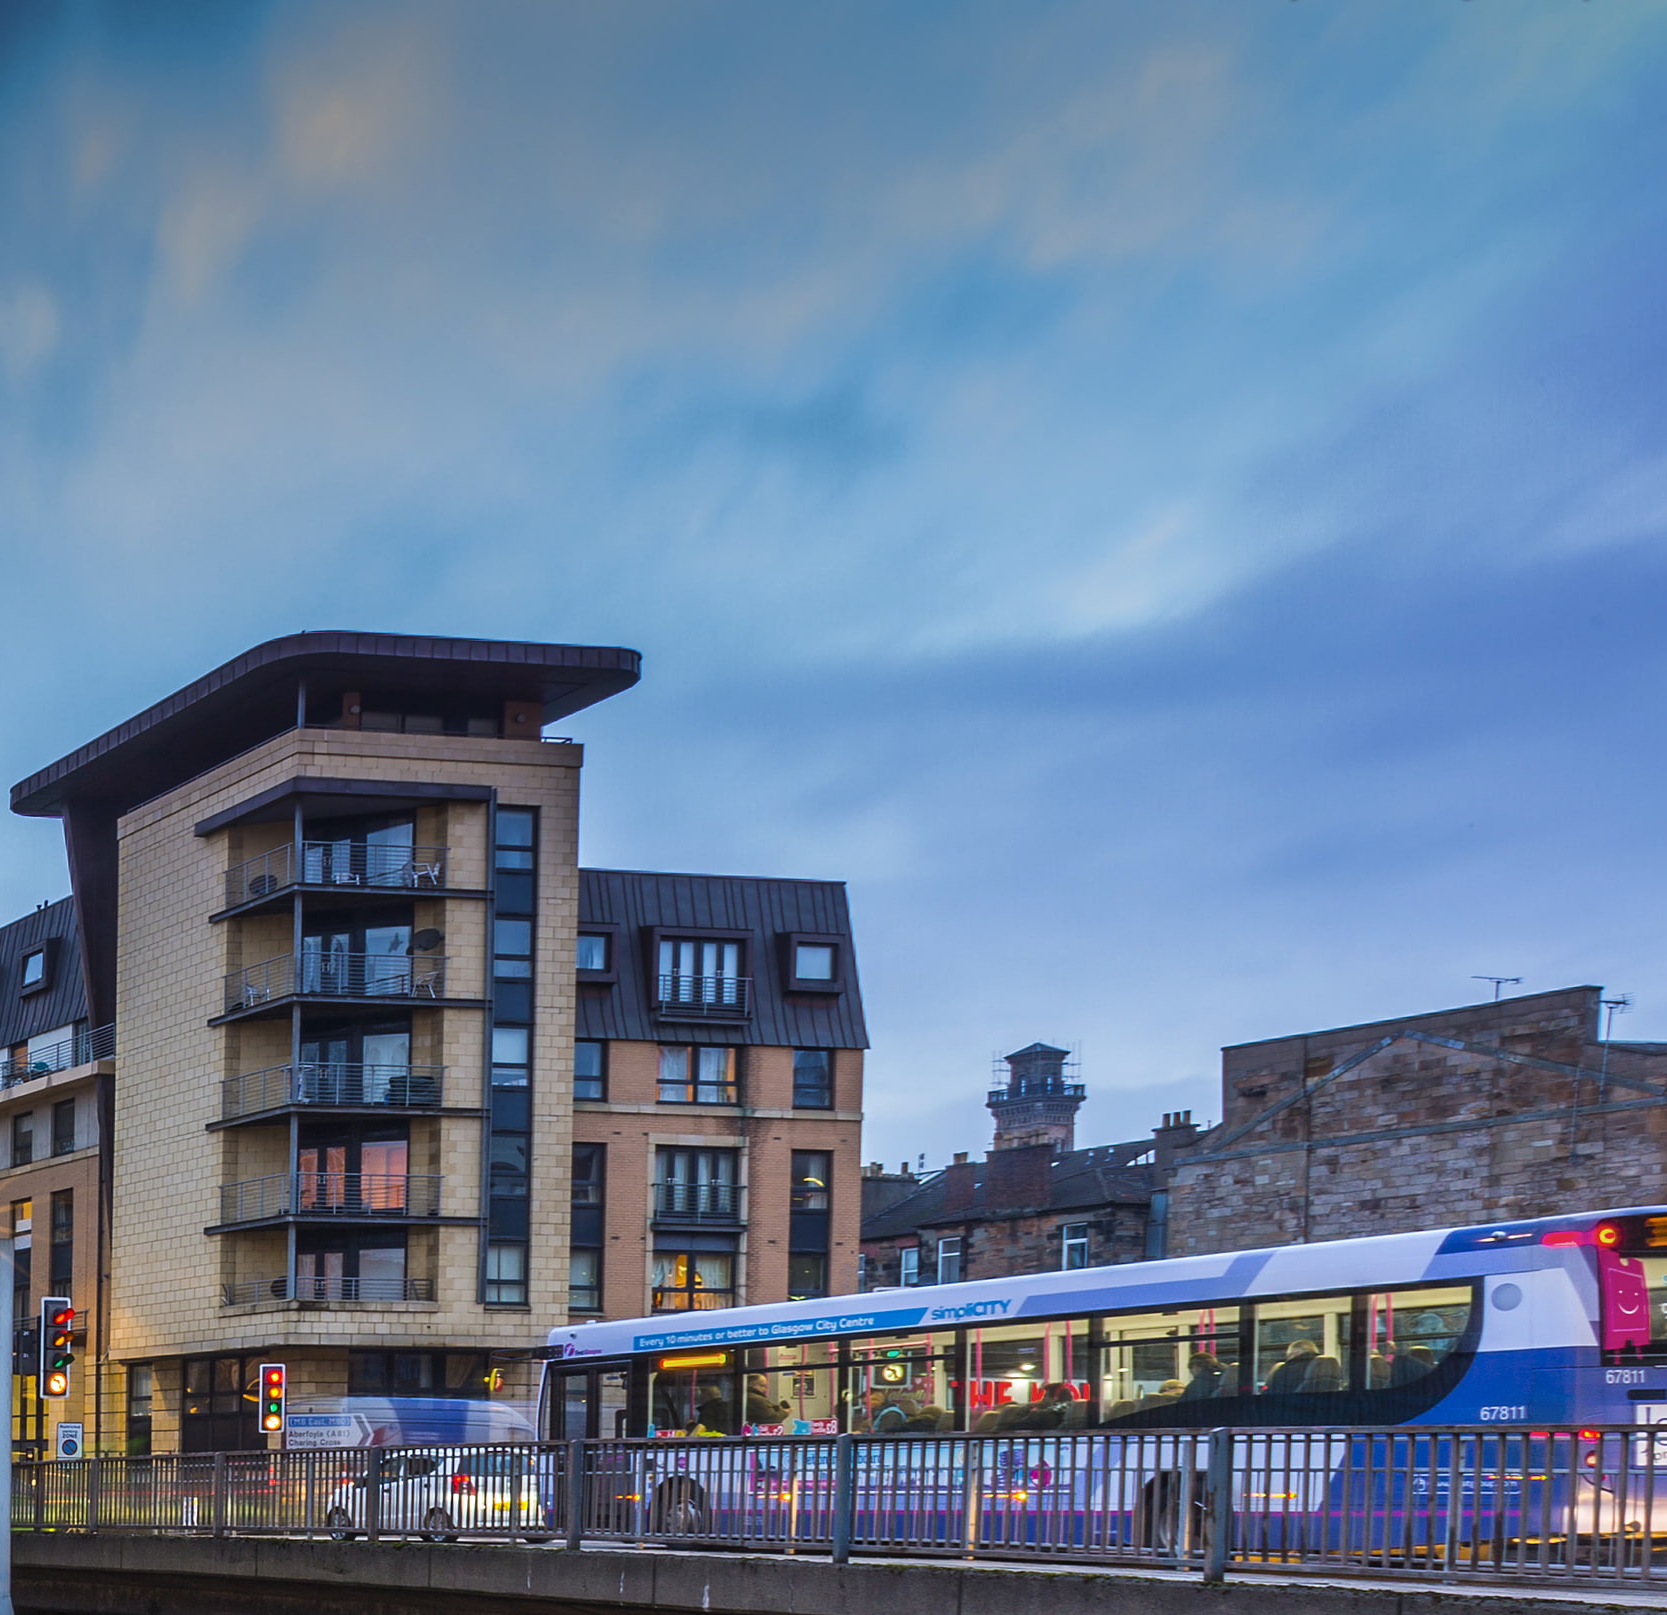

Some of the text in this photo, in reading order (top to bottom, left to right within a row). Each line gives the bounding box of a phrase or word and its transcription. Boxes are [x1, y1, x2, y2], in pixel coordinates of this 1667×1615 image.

[931, 1299, 1012, 1321] simpliCITY
[639, 1316, 875, 1347] Every 10 minutes or better to Glasgow City Centre
[1605, 1369, 1646, 1384] 67811
[1479, 1405, 1526, 1421] 67811
[288, 1430, 324, 1438] Aberfoyle
[288, 1439, 317, 1447] Charing
